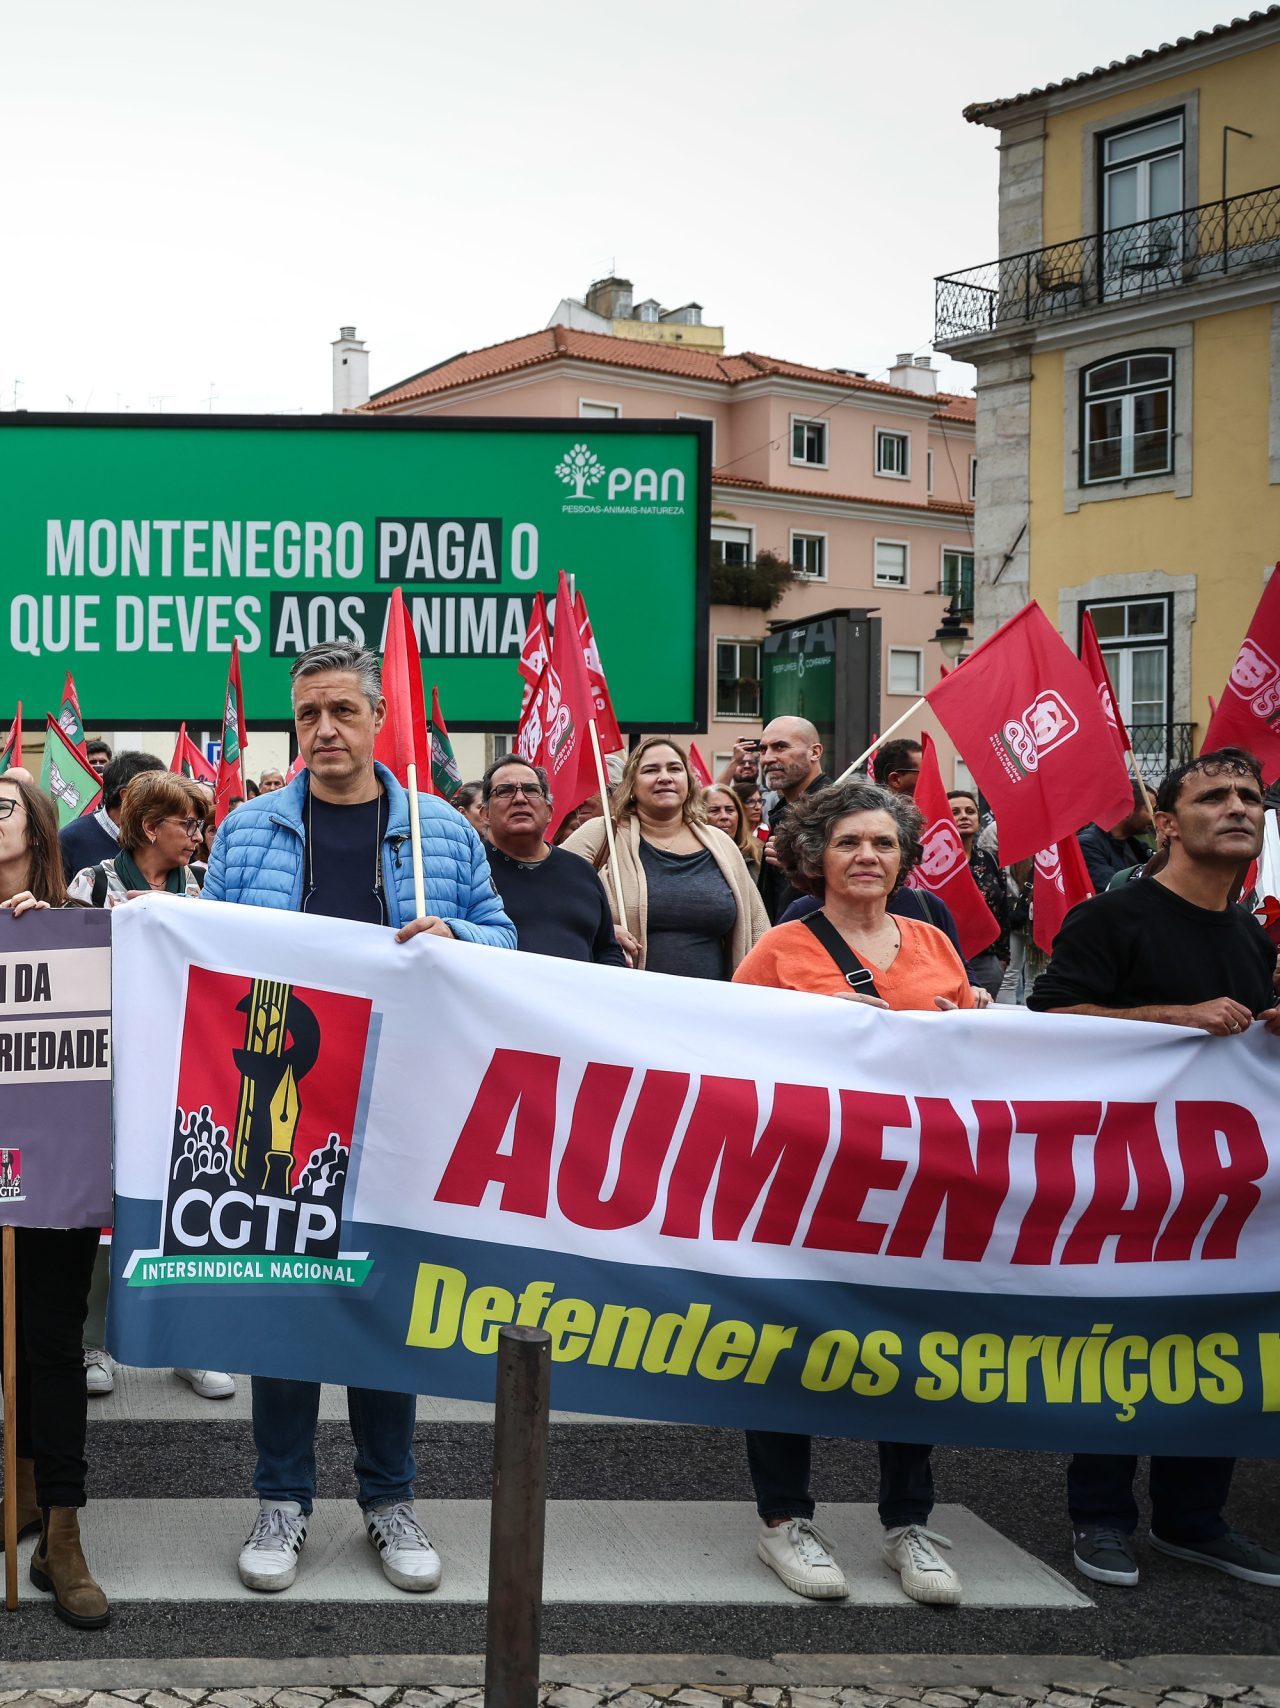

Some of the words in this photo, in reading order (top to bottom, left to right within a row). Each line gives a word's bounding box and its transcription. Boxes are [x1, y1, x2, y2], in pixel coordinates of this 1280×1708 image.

[562, 505, 685, 515] PESSOAS-ANIMAIS-NATUREZA
[608, 467, 685, 501] PAN
[46, 519, 364, 579] MONTENEGRO
[379, 521, 497, 579] PAGA
[510, 523, 539, 580] O
[10, 595, 100, 656] QUE
[116, 596, 262, 653] DEVES
[275, 596, 366, 653] AOS
[14, 962, 52, 1003] DA
[434, 1048, 1268, 1266] AUMENTAR
[171, 1188, 337, 1254] CGTP
[142, 1261, 264, 1280] INTERSINDICAL
[271, 1263, 355, 1282] NACIONAL
[406, 1262, 799, 1385] Defender
[800, 1329, 902, 1396] os
[914, 1323, 1244, 1422] serviços
